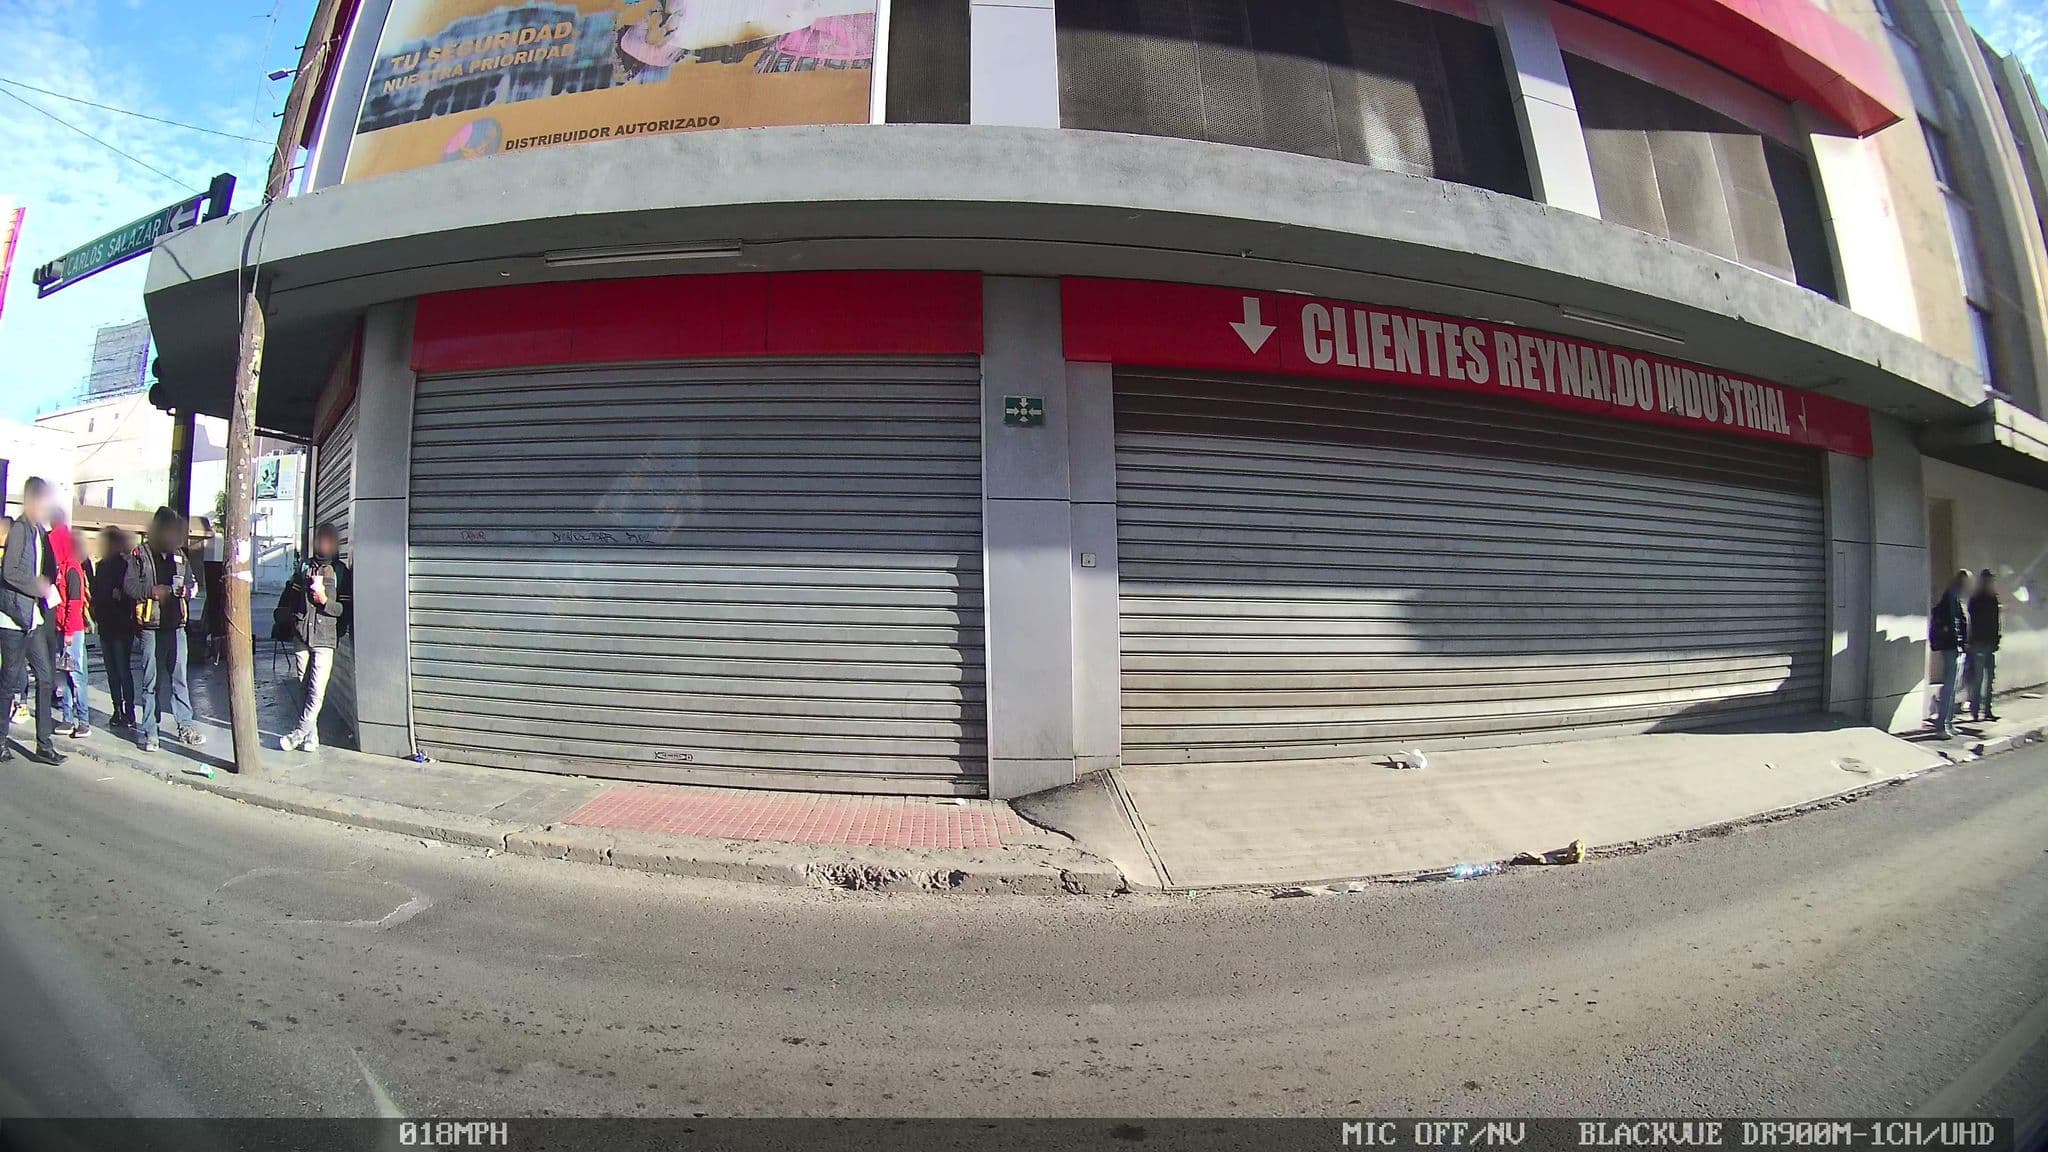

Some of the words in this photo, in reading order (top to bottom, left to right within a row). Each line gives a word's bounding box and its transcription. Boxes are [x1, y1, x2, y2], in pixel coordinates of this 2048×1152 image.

[383, 65, 464, 93] NUESTRA
[469, 43, 575, 74] PRIORIDAD
[391, 50, 421, 72] TU
[427, 21, 574, 64] SEGURIDAD
[505, 126, 610, 151] DISTRIBUIDOR
[614, 115, 721, 138] AUTORIZADO
[67, 244, 103, 276] CARLOS
[107, 217, 162, 257] SALAZAR
[1301, 303, 1490, 385] CLIENTES
[1494, 331, 1654, 411] REYNALDO
[1655, 362, 1791, 435] INDUSTRIAL
